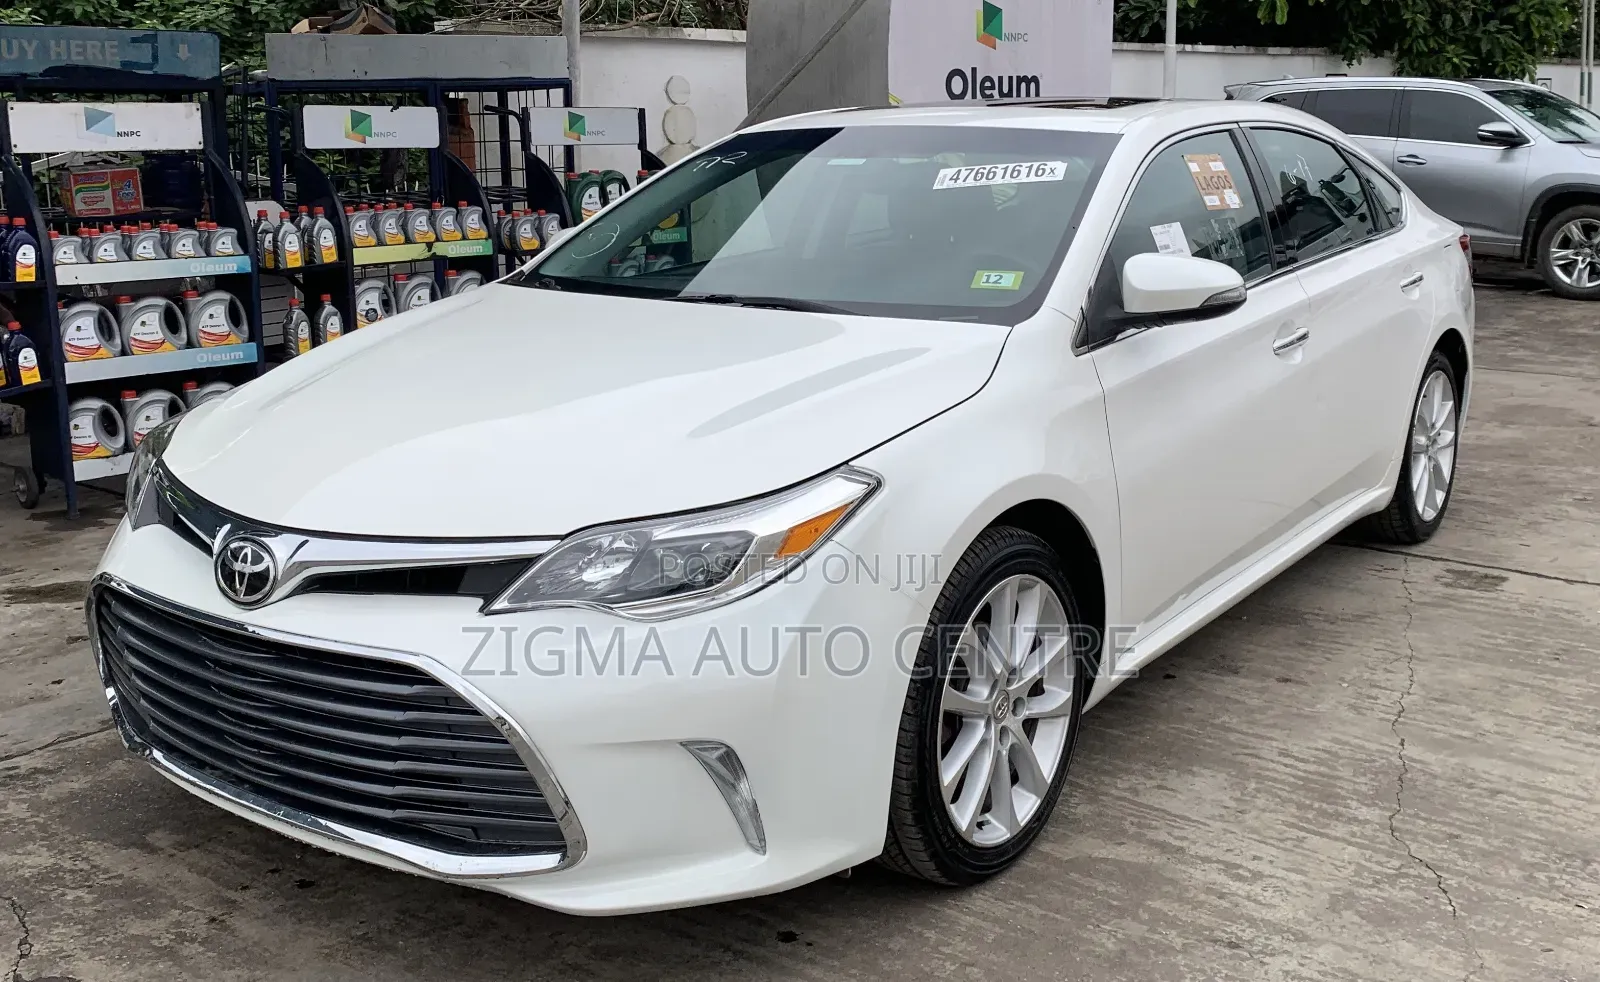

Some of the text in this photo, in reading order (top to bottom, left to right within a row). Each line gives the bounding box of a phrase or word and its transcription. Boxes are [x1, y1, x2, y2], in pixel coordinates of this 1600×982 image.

[1003, 32, 1029, 42] NNPC
[49, 40, 120, 61] HERE
[945, 66, 1041, 100] Oleum
[116, 130, 141, 138] NNPC
[1195, 174, 1233, 193] LAGOS
[654, 232, 680, 241] Oleum
[448, 243, 483, 255] Oleum
[190, 261, 238, 274] Oleum
[981, 273, 1004, 285] 12
[196, 351, 244, 363] Oleum
